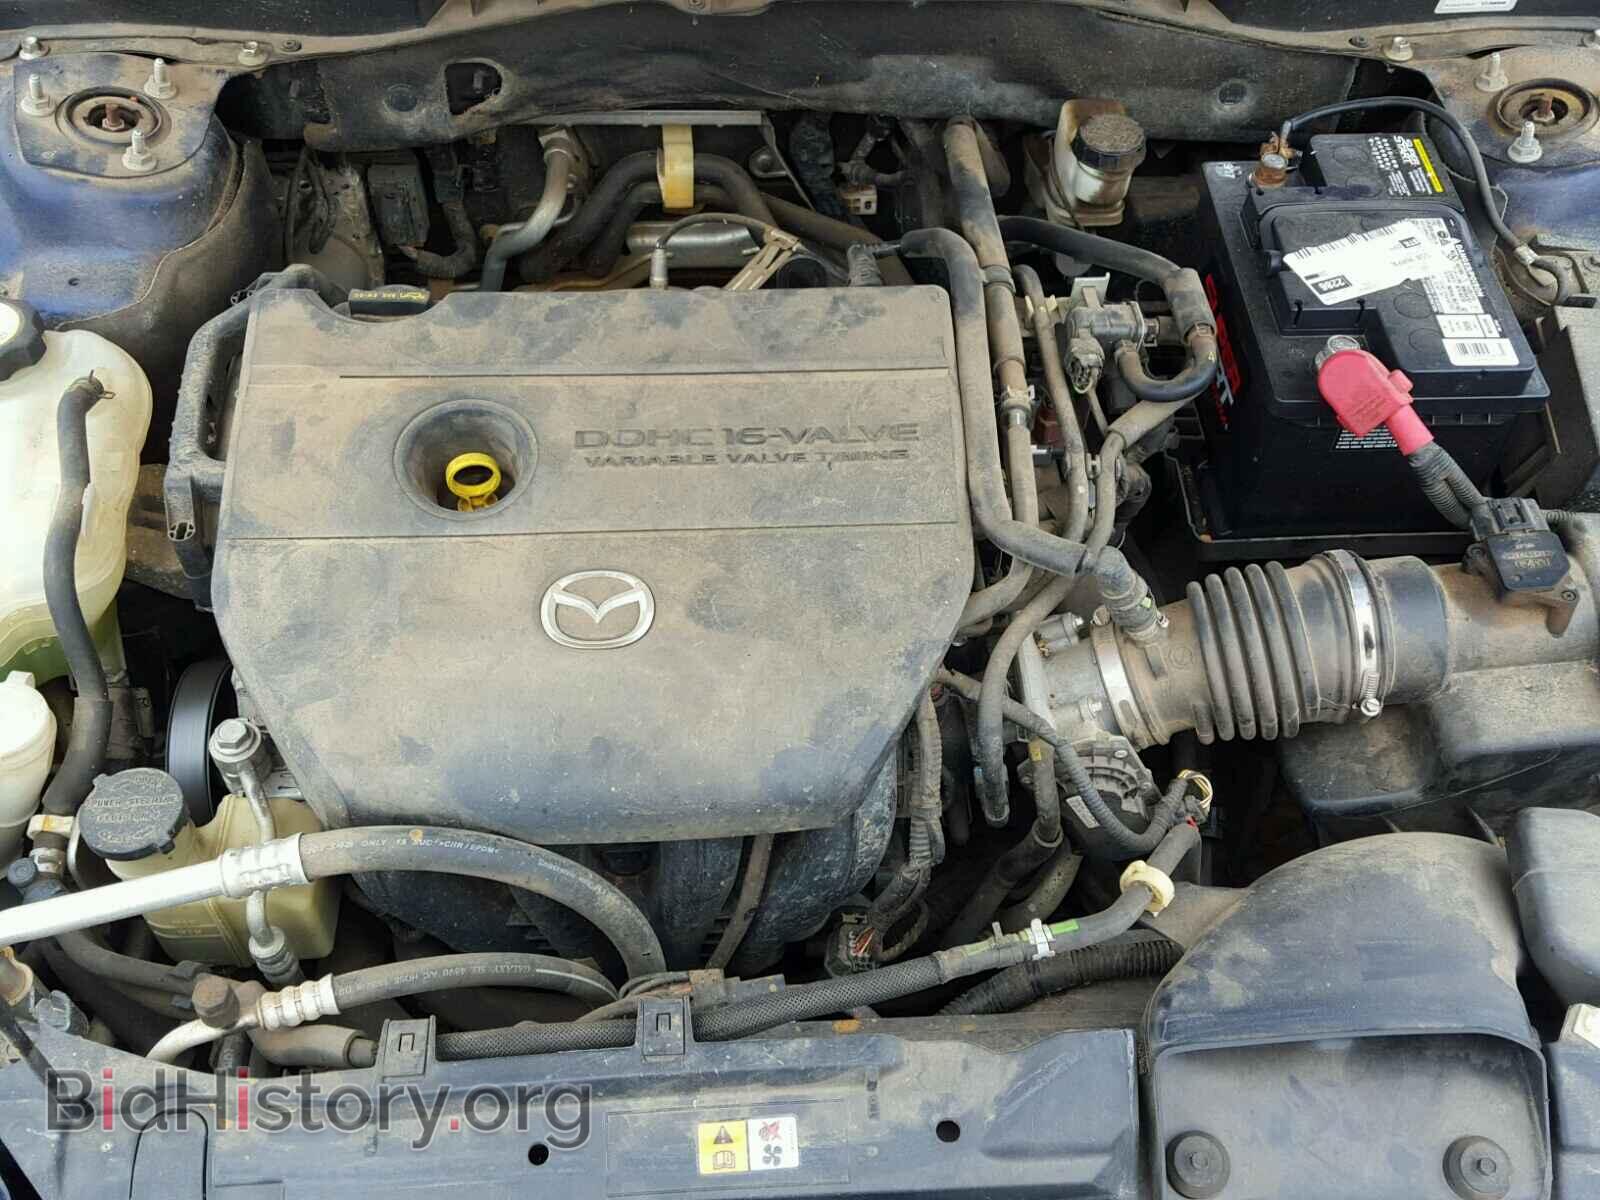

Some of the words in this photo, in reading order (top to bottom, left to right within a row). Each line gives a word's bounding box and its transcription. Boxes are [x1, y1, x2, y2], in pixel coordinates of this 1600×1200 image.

[721, 423, 920, 445] 16-VALVE
[584, 454, 719, 468] VARIABLE
[726, 452, 808, 464] VALVE
